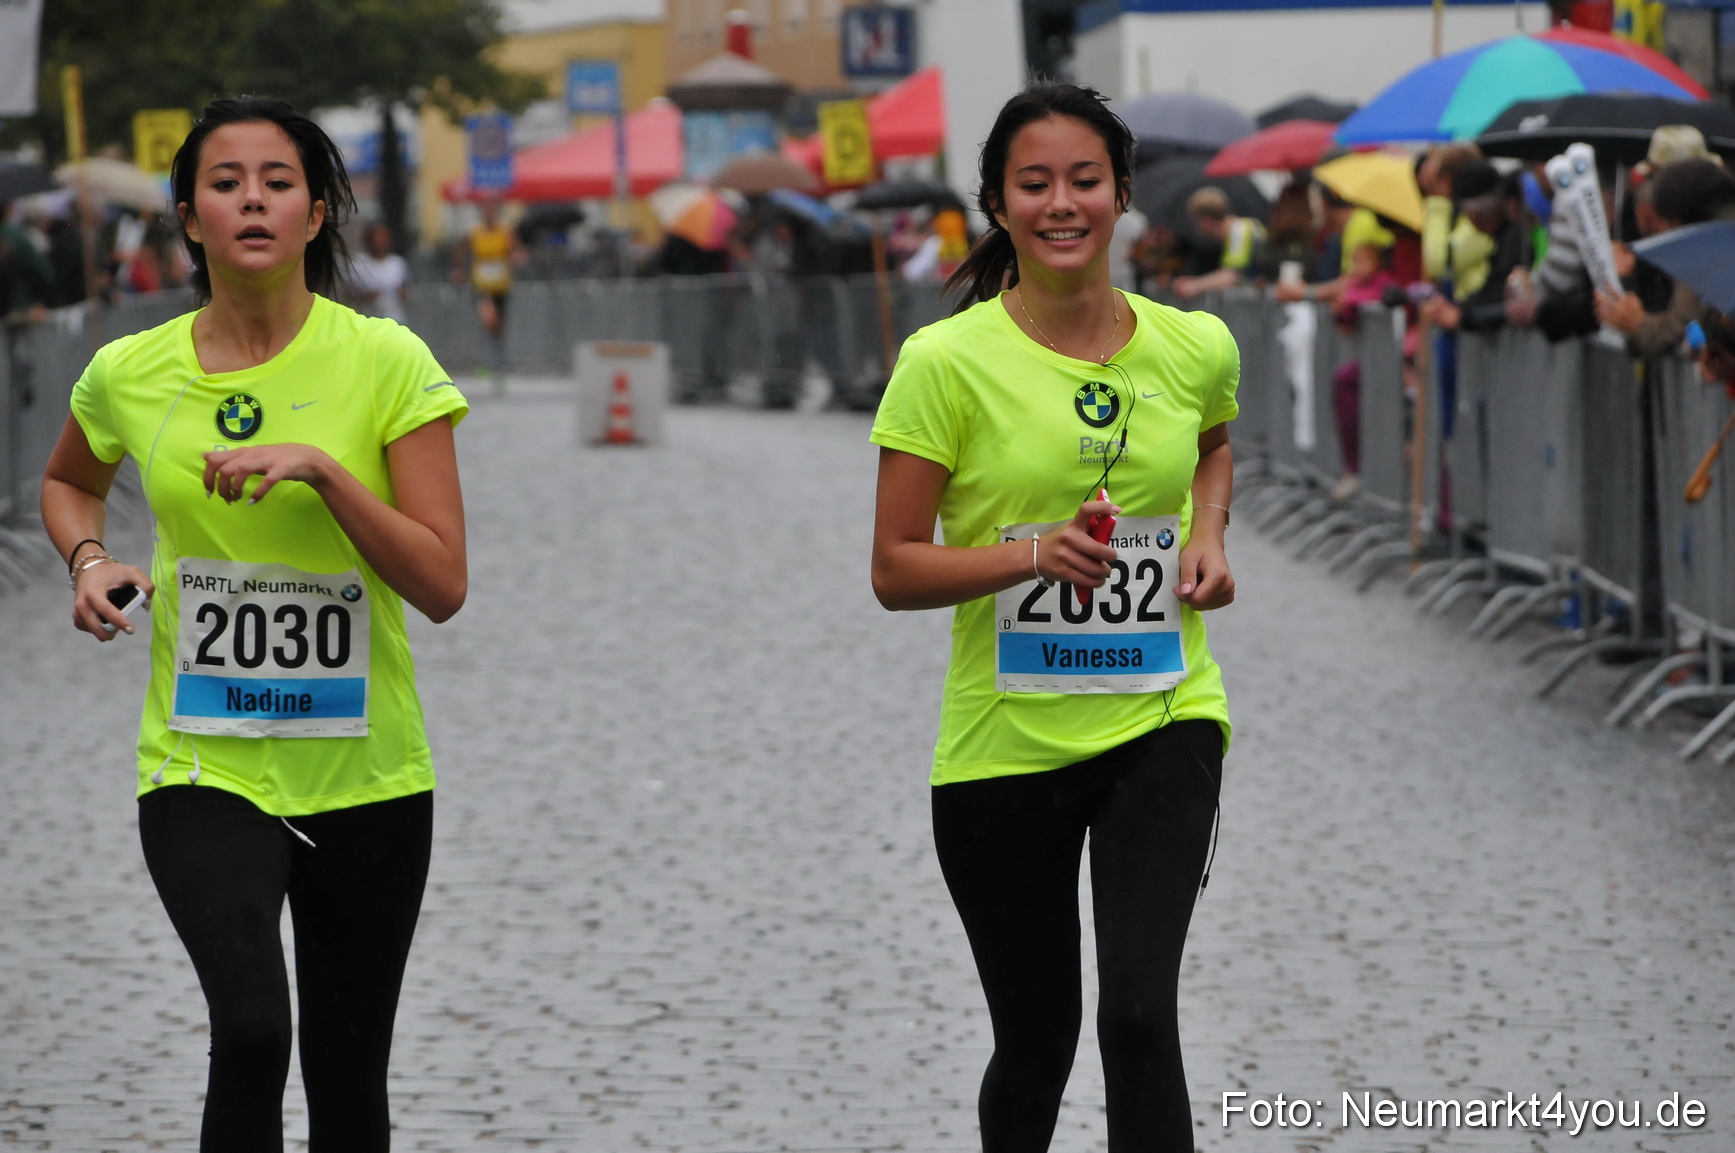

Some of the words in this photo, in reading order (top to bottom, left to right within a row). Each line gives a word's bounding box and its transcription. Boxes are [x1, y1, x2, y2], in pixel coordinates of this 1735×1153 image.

[1076, 383, 1116, 400] BMW
[220, 395, 260, 412] BMW
[1079, 455, 1129, 464] Neumakt
[1110, 532, 1150, 549] markt
[182, 574, 239, 594] PARTL
[243, 579, 334, 597] Neumarkt
[1017, 558, 1166, 625] 2032
[1003, 618, 1012, 630] D
[195, 602, 351, 669] 2030
[1041, 642, 1143, 668] Vanessa
[226, 686, 313, 713] Nadine
